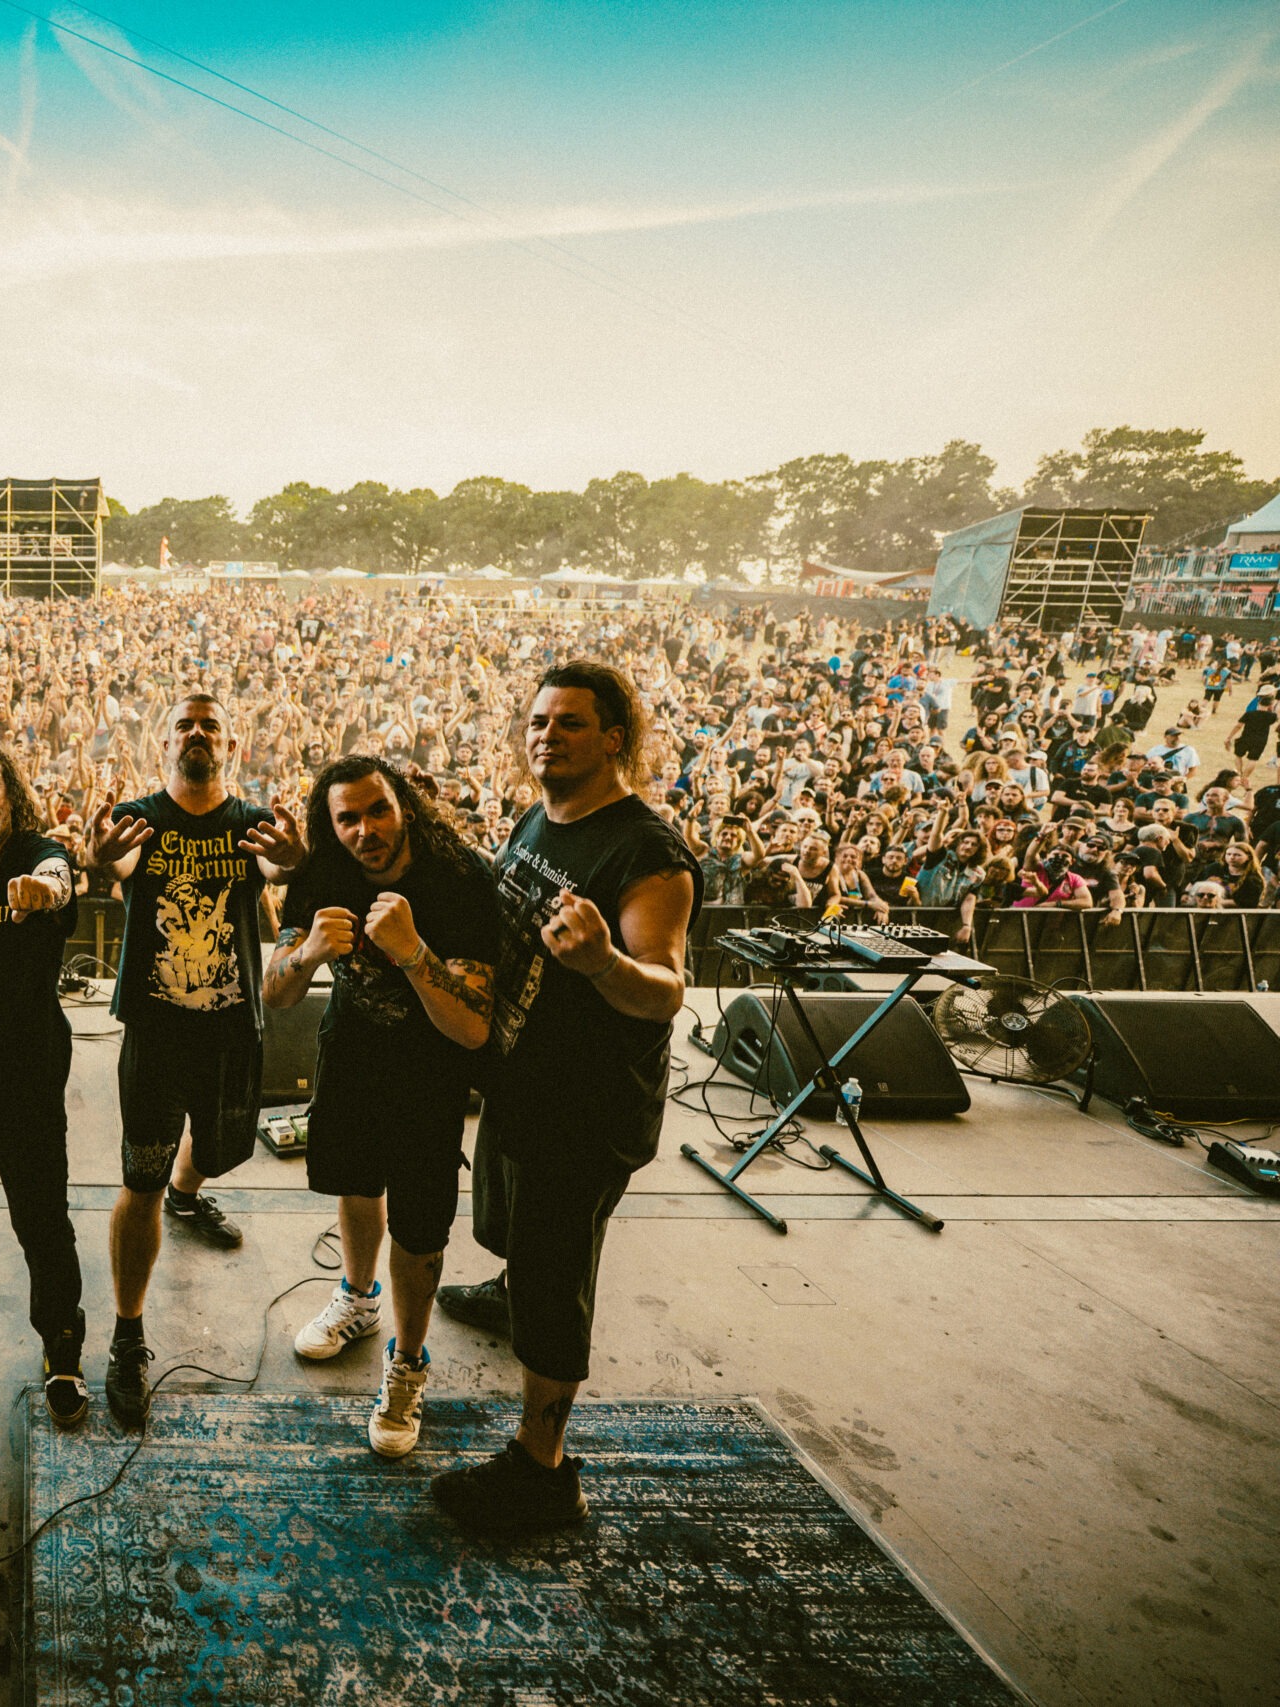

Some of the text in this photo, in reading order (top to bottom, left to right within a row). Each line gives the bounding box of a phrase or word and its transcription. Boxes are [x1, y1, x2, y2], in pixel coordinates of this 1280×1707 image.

[161, 829, 234, 858] Eternal
[146, 850, 248, 881] Suffering
[531, 853, 540, 870] &
[538, 858, 578, 893] Punisher
